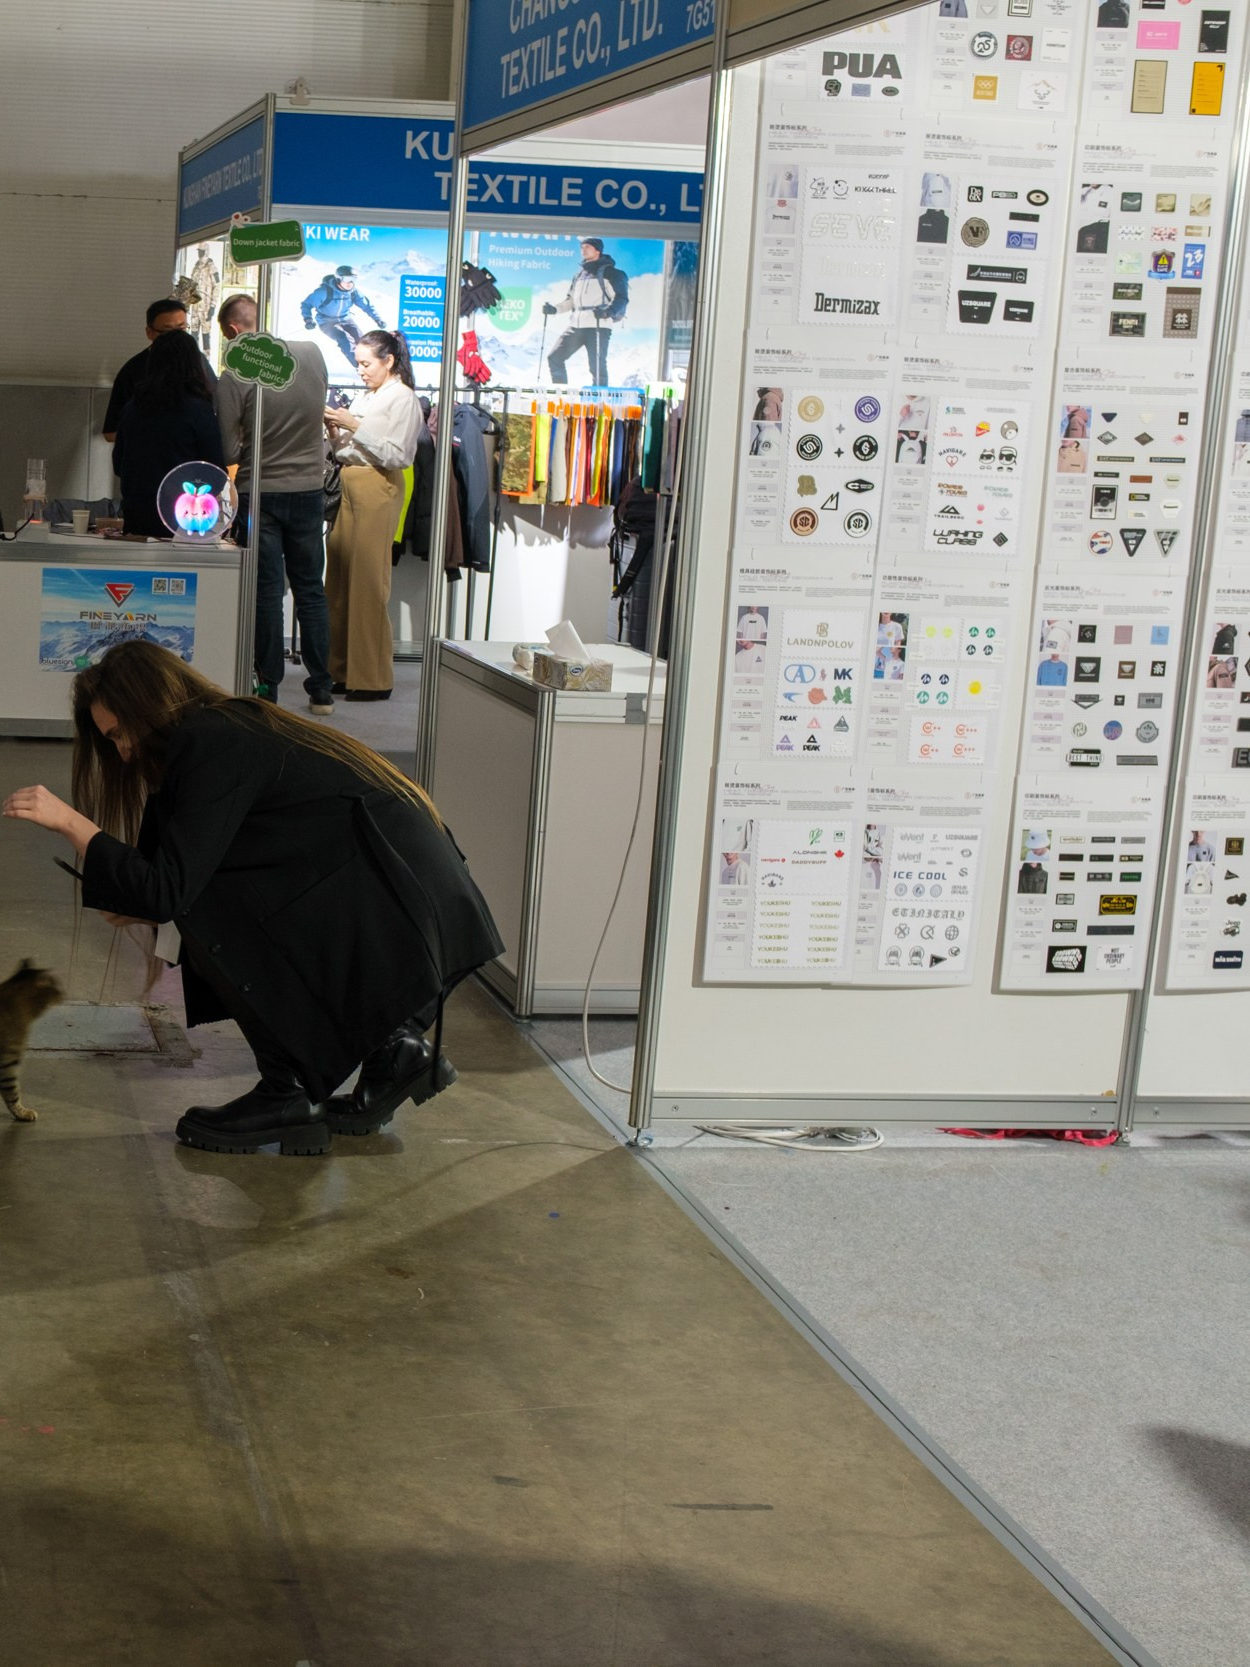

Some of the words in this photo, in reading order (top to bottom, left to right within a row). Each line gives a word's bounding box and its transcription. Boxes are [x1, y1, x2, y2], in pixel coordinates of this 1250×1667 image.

[501, 26, 568, 98] TEXTILE
[572, 12, 611, 68] CO.,
[617, 0, 663, 51] LTD.
[822, 51, 902, 79] PUA
[595, 179, 667, 217] CO.,
[306, 225, 321, 239] KI
[324, 226, 370, 242] WEAR
[233, 238, 254, 246] Down
[255, 239, 278, 248] jacket
[279, 239, 301, 247] fabric
[489, 244, 532, 255] Premium
[534, 246, 574, 257] Outdoor
[488, 258, 520, 270] Hiking
[521, 260, 551, 269] Fabric
[1184, 249, 1203, 267] 23
[404, 286, 442, 299] 30000
[814, 292, 881, 315] Dermizax
[402, 316, 440, 329] 20000
[240, 342, 273, 360] Outdoor
[242, 352, 282, 373] functional
[259, 369, 285, 384] fabrics
[79, 611, 158, 622] FINEYARN
[833, 668, 853, 680] MK
[893, 871, 913, 879] ICE
[918, 872, 947, 880] COOL
[1225, 919, 1241, 927] Jeep
